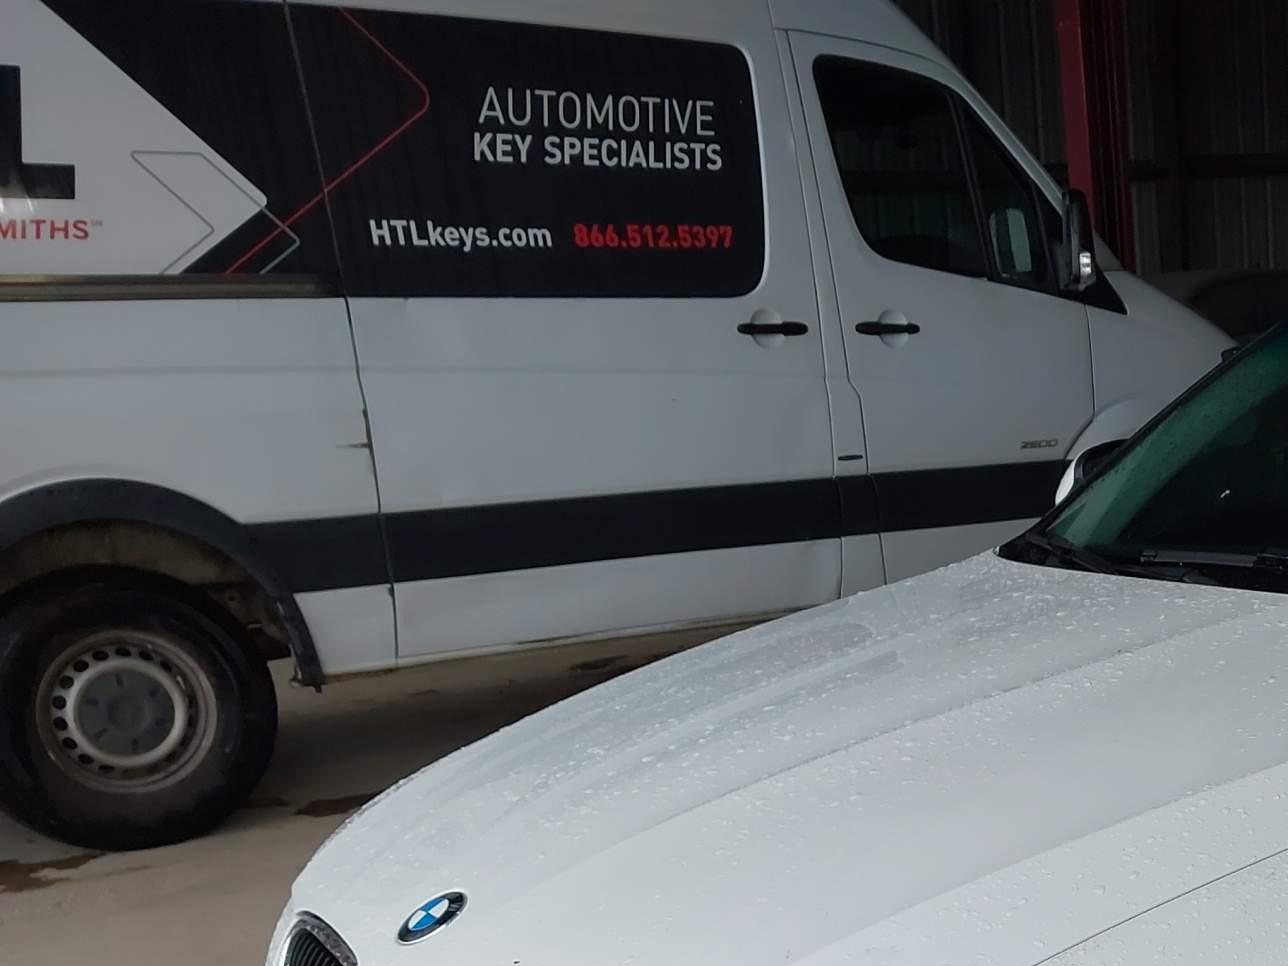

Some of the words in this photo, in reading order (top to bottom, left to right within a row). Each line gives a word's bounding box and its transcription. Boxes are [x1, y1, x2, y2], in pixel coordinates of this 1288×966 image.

[478, 86, 716, 136] AUTOMOTIVE
[473, 131, 533, 164] KEY
[543, 136, 723, 171] SPECIALISTS
[369, 219, 553, 252] HTLkeys.com
[573, 223, 733, 249] 866.512.5397
